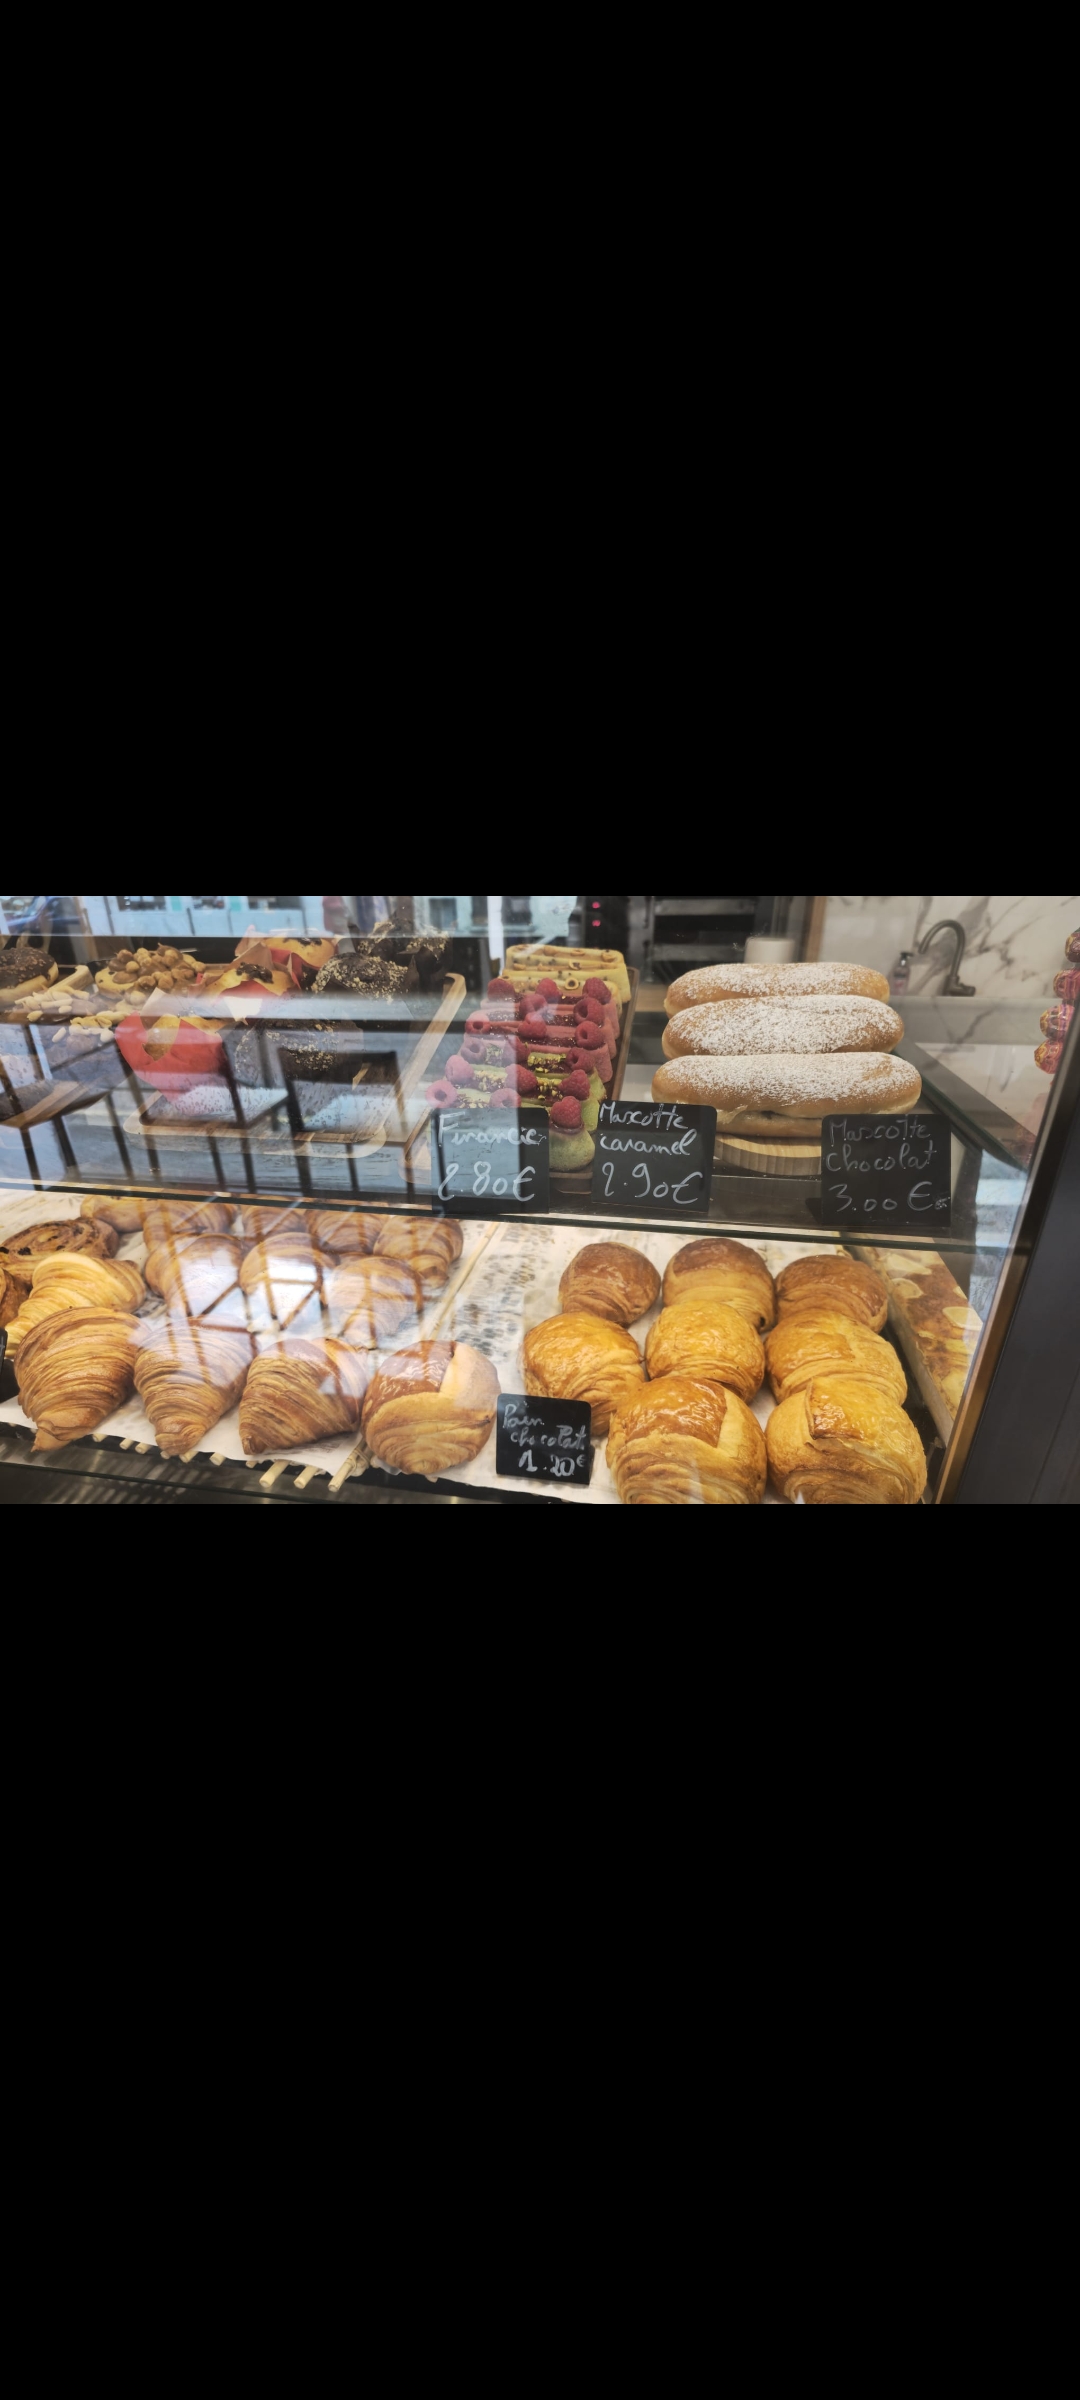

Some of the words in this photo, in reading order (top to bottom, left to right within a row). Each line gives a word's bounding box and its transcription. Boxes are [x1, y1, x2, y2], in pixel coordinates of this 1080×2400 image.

[600, 1101, 688, 1130] Mascotte
[600, 1128, 697, 1155] caramel
[829, 1114, 931, 1147] Mascotte
[602, 1162, 703, 1204] 2.90€
[503, 1403, 545, 1428] Pain
